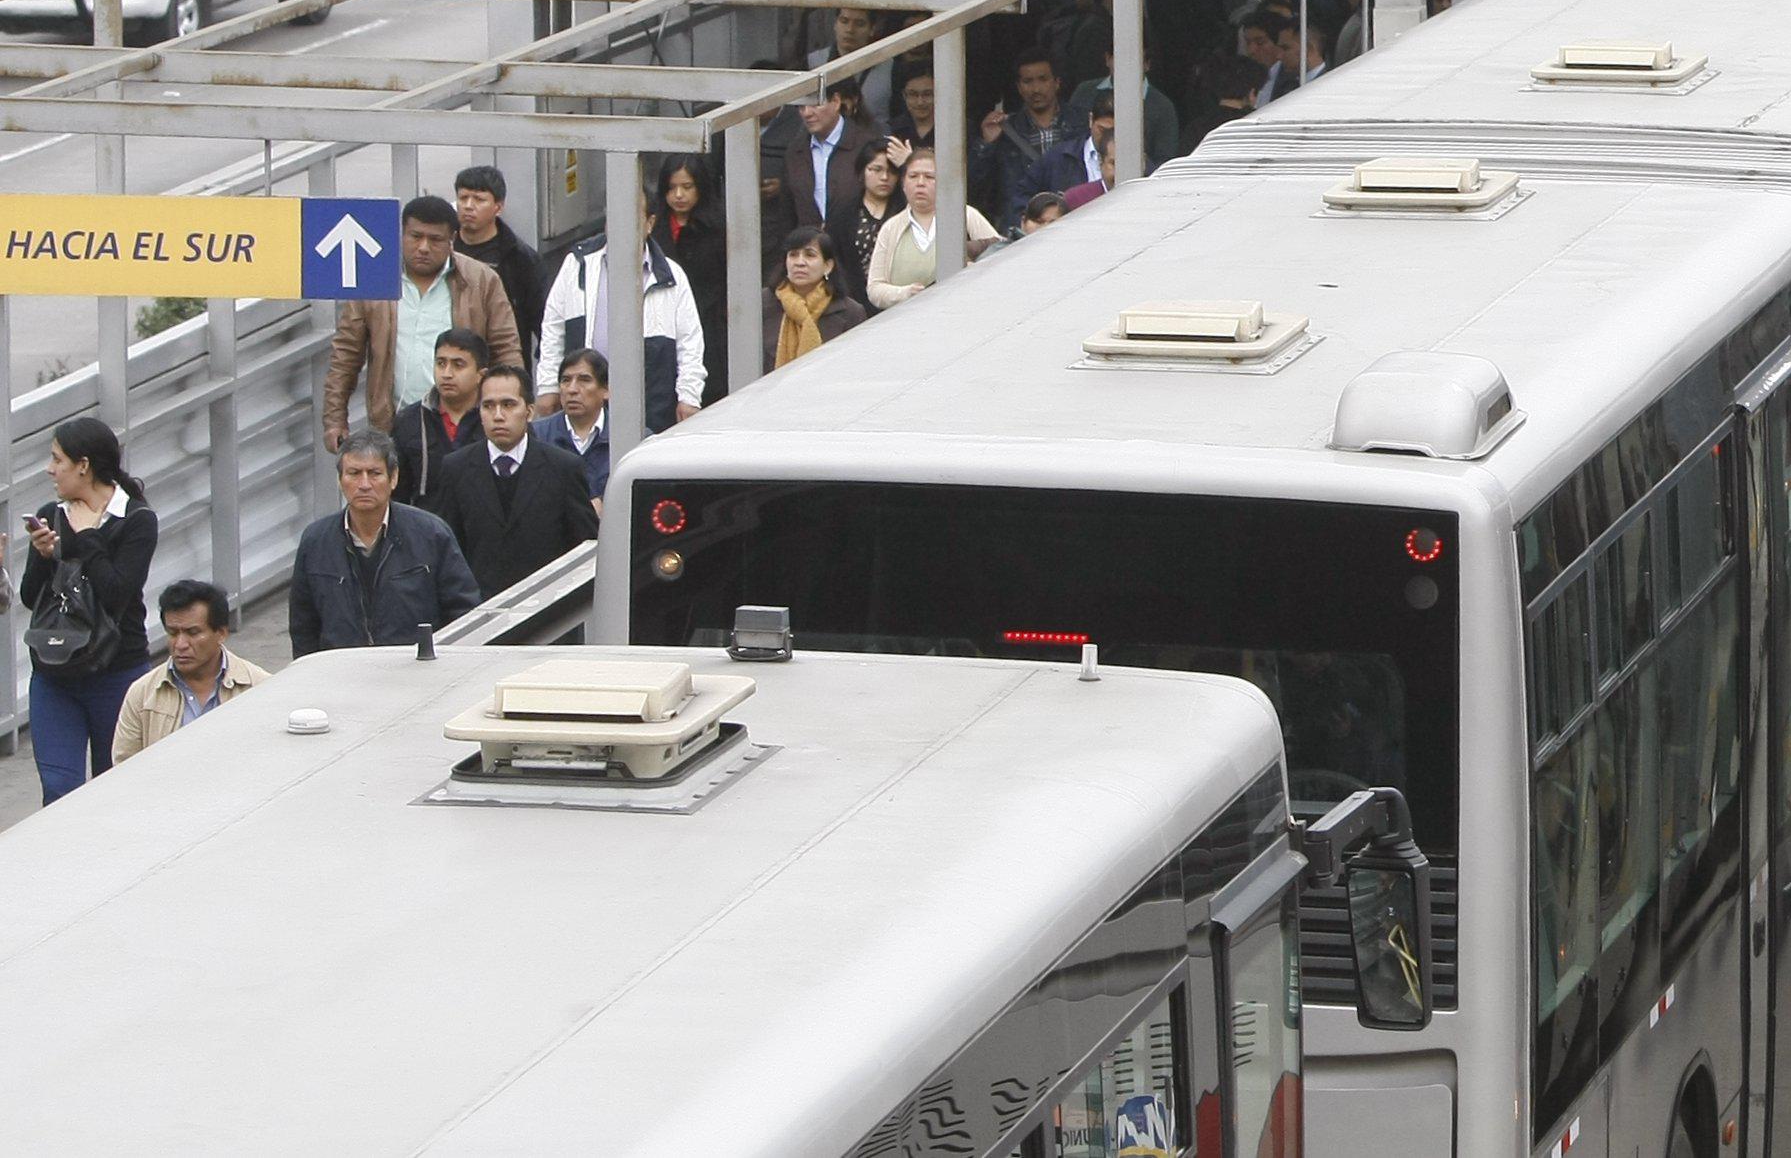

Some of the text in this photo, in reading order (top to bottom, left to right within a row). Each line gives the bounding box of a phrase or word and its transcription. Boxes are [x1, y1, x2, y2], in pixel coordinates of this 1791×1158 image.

[5, 230, 255, 263] HACIA EL SUR
